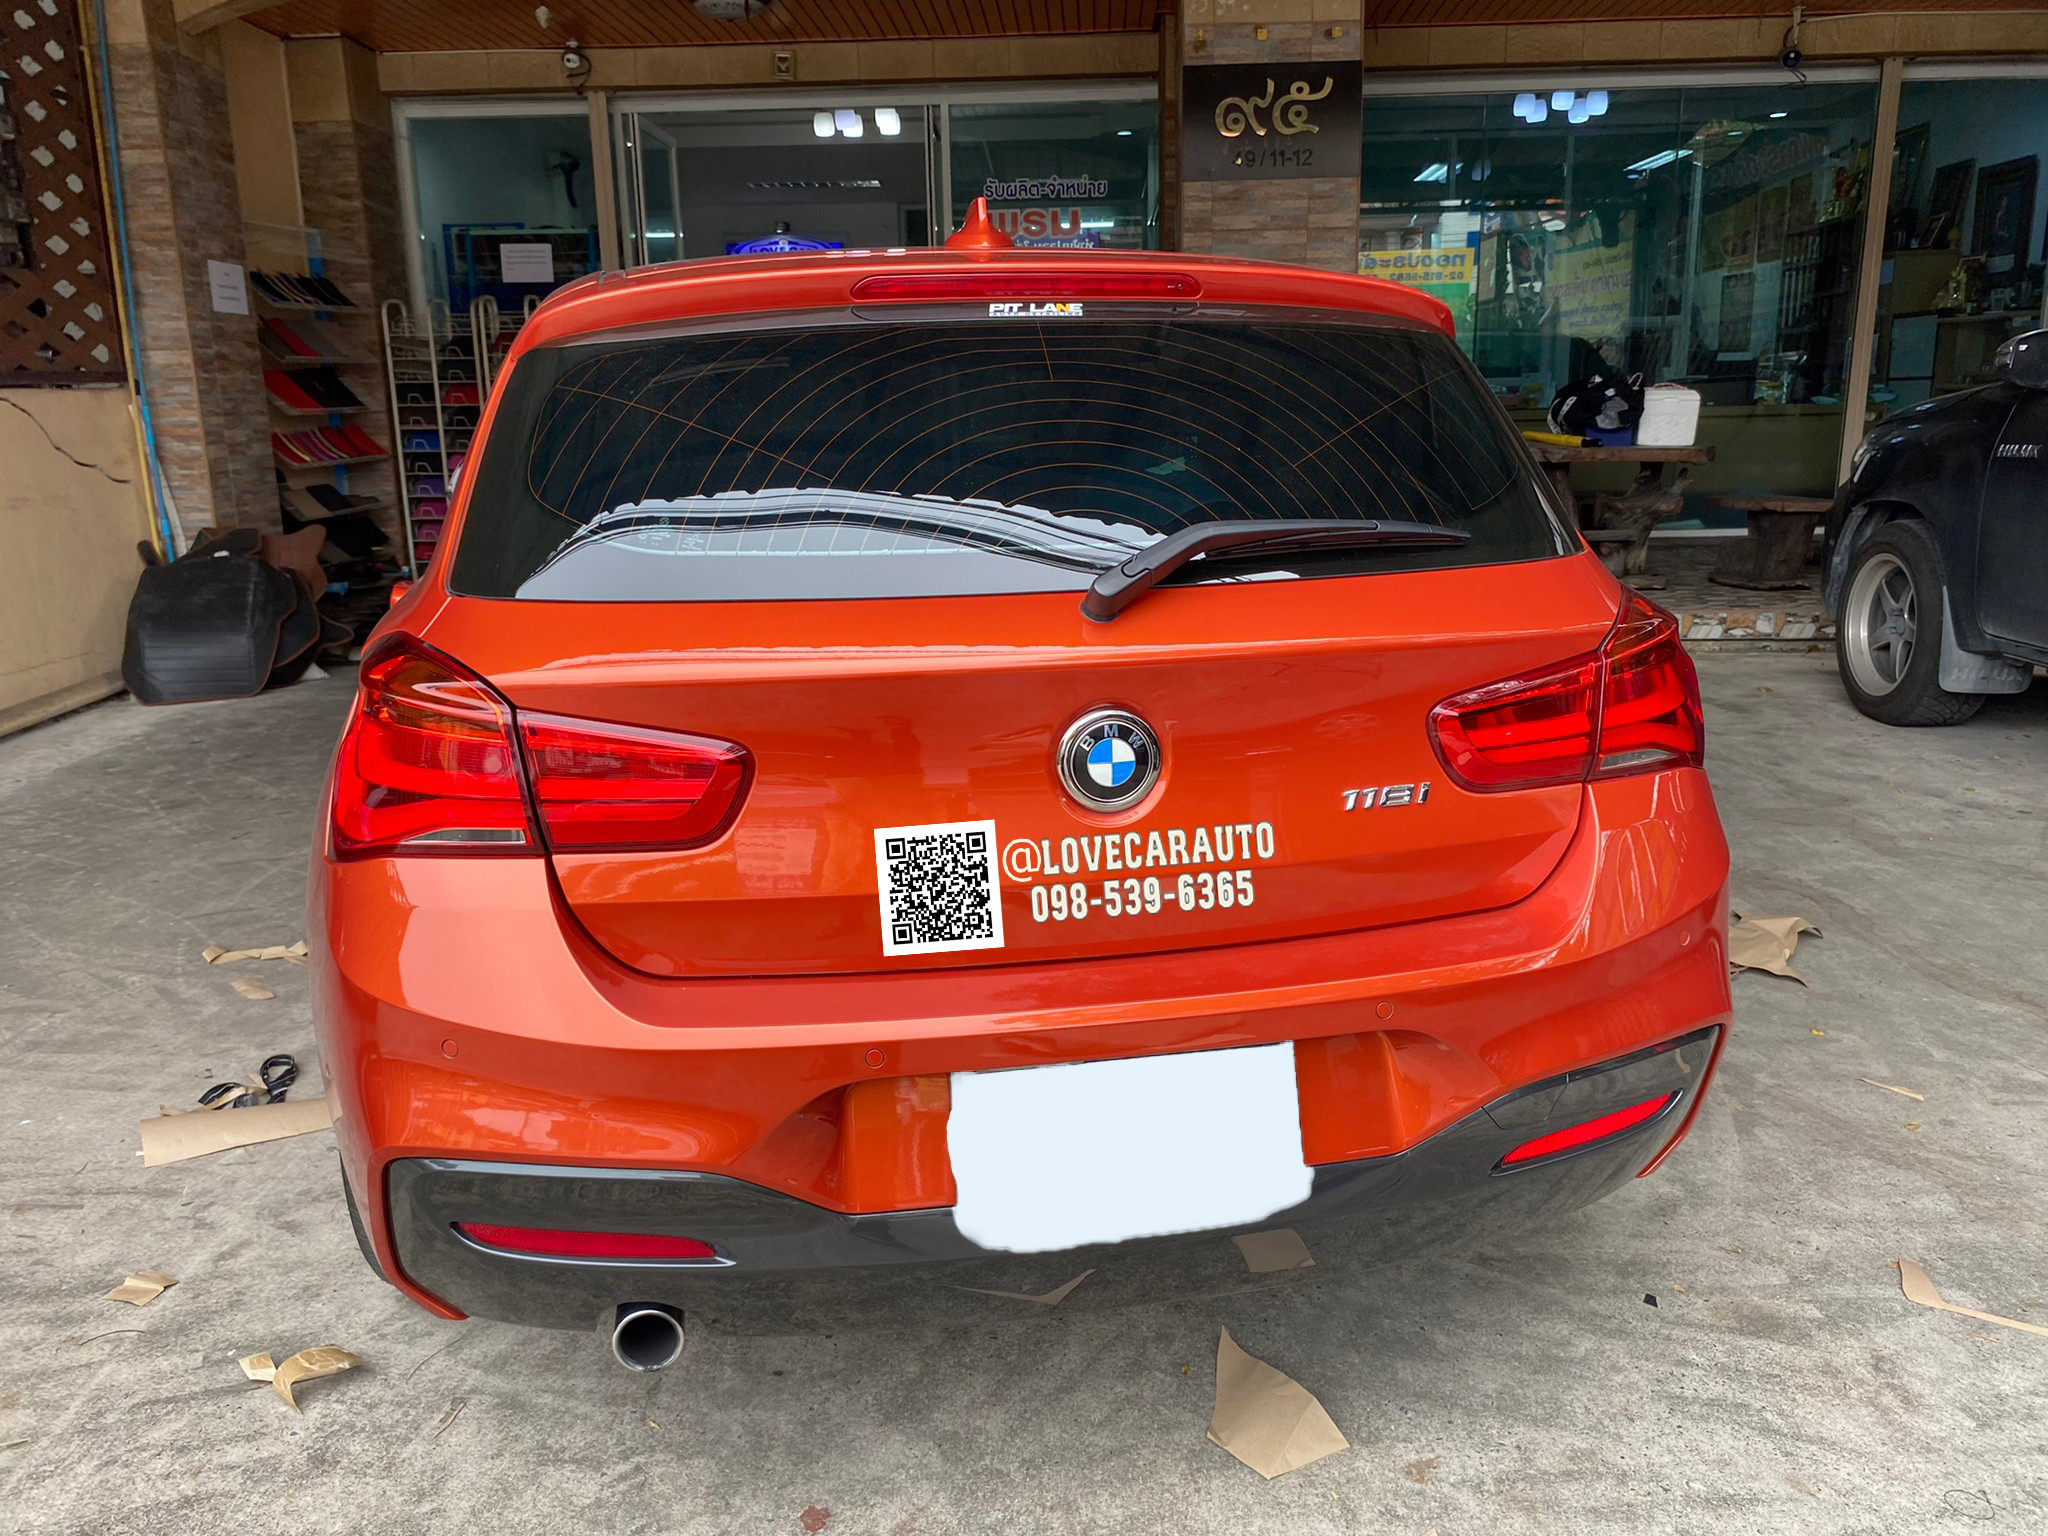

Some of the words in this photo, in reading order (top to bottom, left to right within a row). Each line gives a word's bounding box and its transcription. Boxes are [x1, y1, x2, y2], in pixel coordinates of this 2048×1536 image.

[1215, 76, 1334, 138] ๙๕
[984, 175, 1108, 199] รับผลิต-จำหน่าย
[989, 303, 1023, 312] PIT
[1029, 303, 1083, 312] LANE
[1079, 724, 1144, 752] BMW
[1341, 781, 1432, 812] 118i
